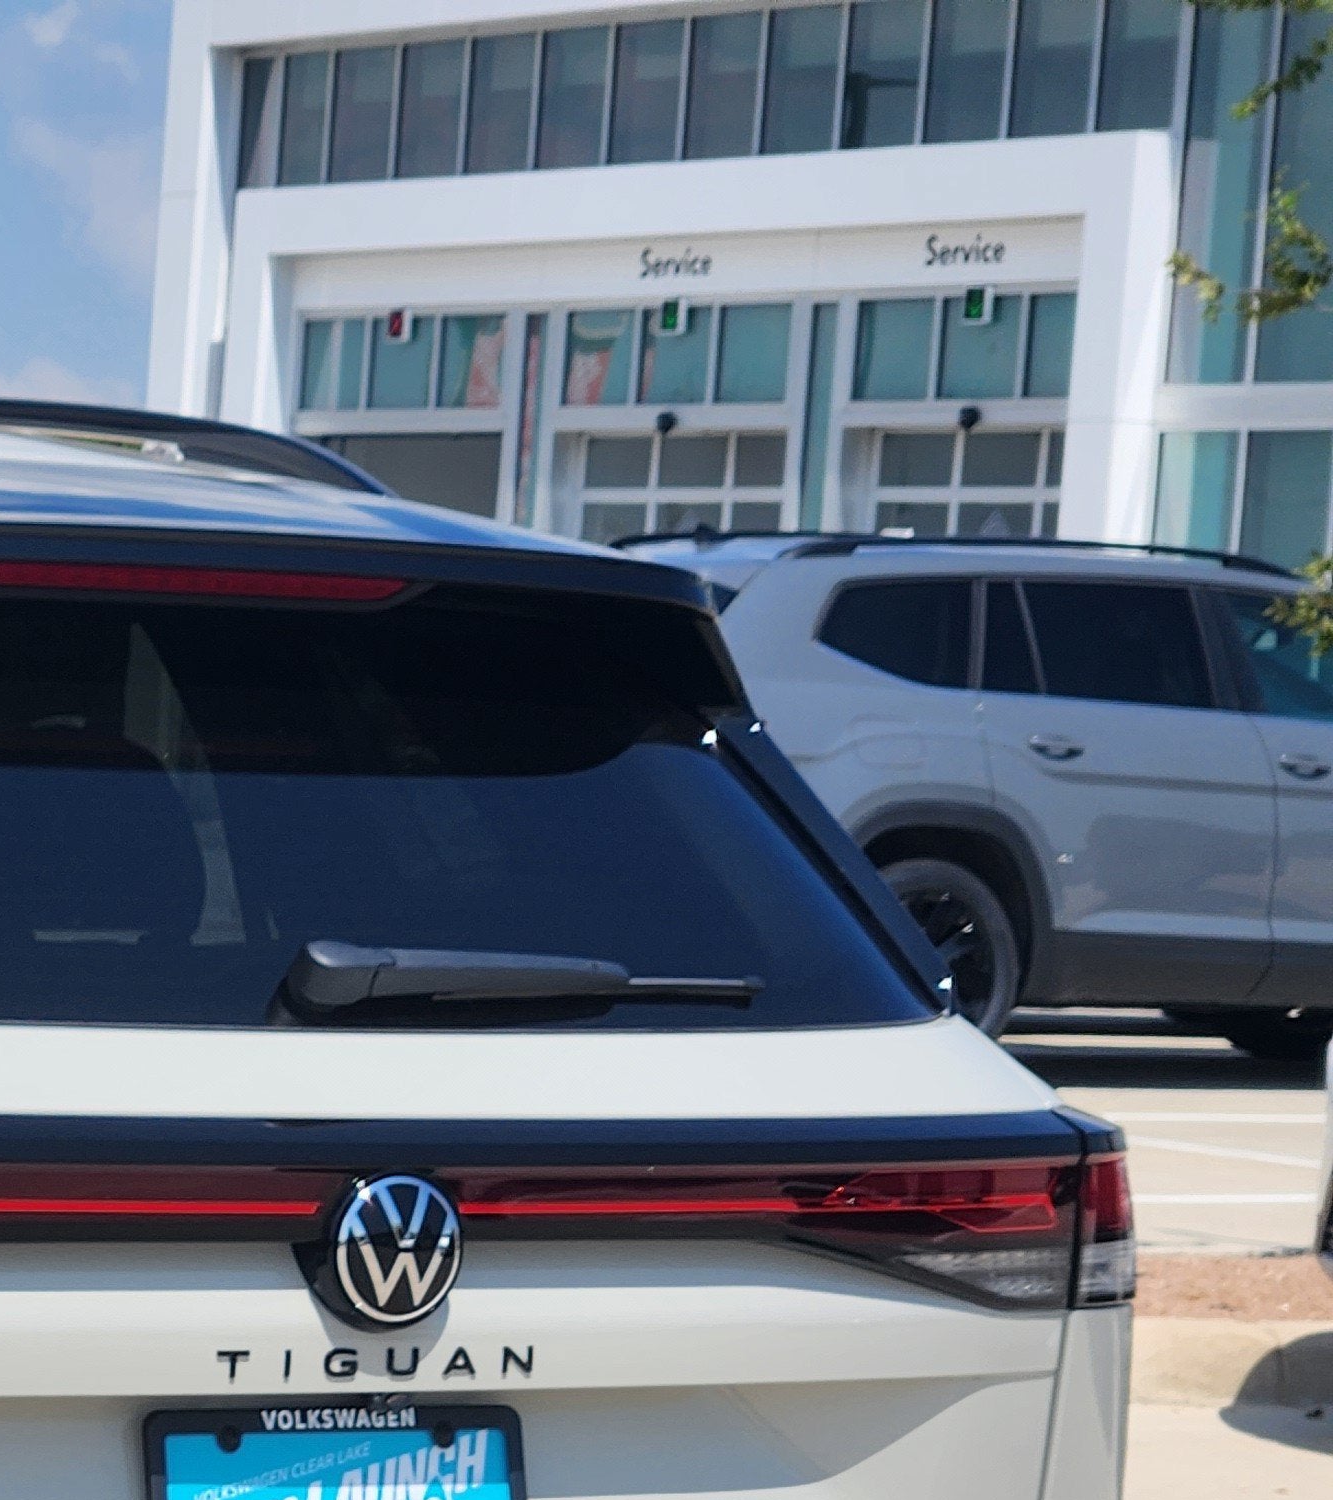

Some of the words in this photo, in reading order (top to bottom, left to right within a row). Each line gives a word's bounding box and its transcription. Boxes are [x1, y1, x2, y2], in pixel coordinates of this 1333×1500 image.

[640, 248, 713, 279] Service
[925, 234, 1006, 267] Service
[336, 1174, 461, 1323] VW
[217, 1345, 534, 1384] TIGUAN
[261, 1407, 417, 1431] VOLKSWAGEN
[291, 1453, 334, 1479] CLEAR
[337, 1440, 372, 1465] LAKE
